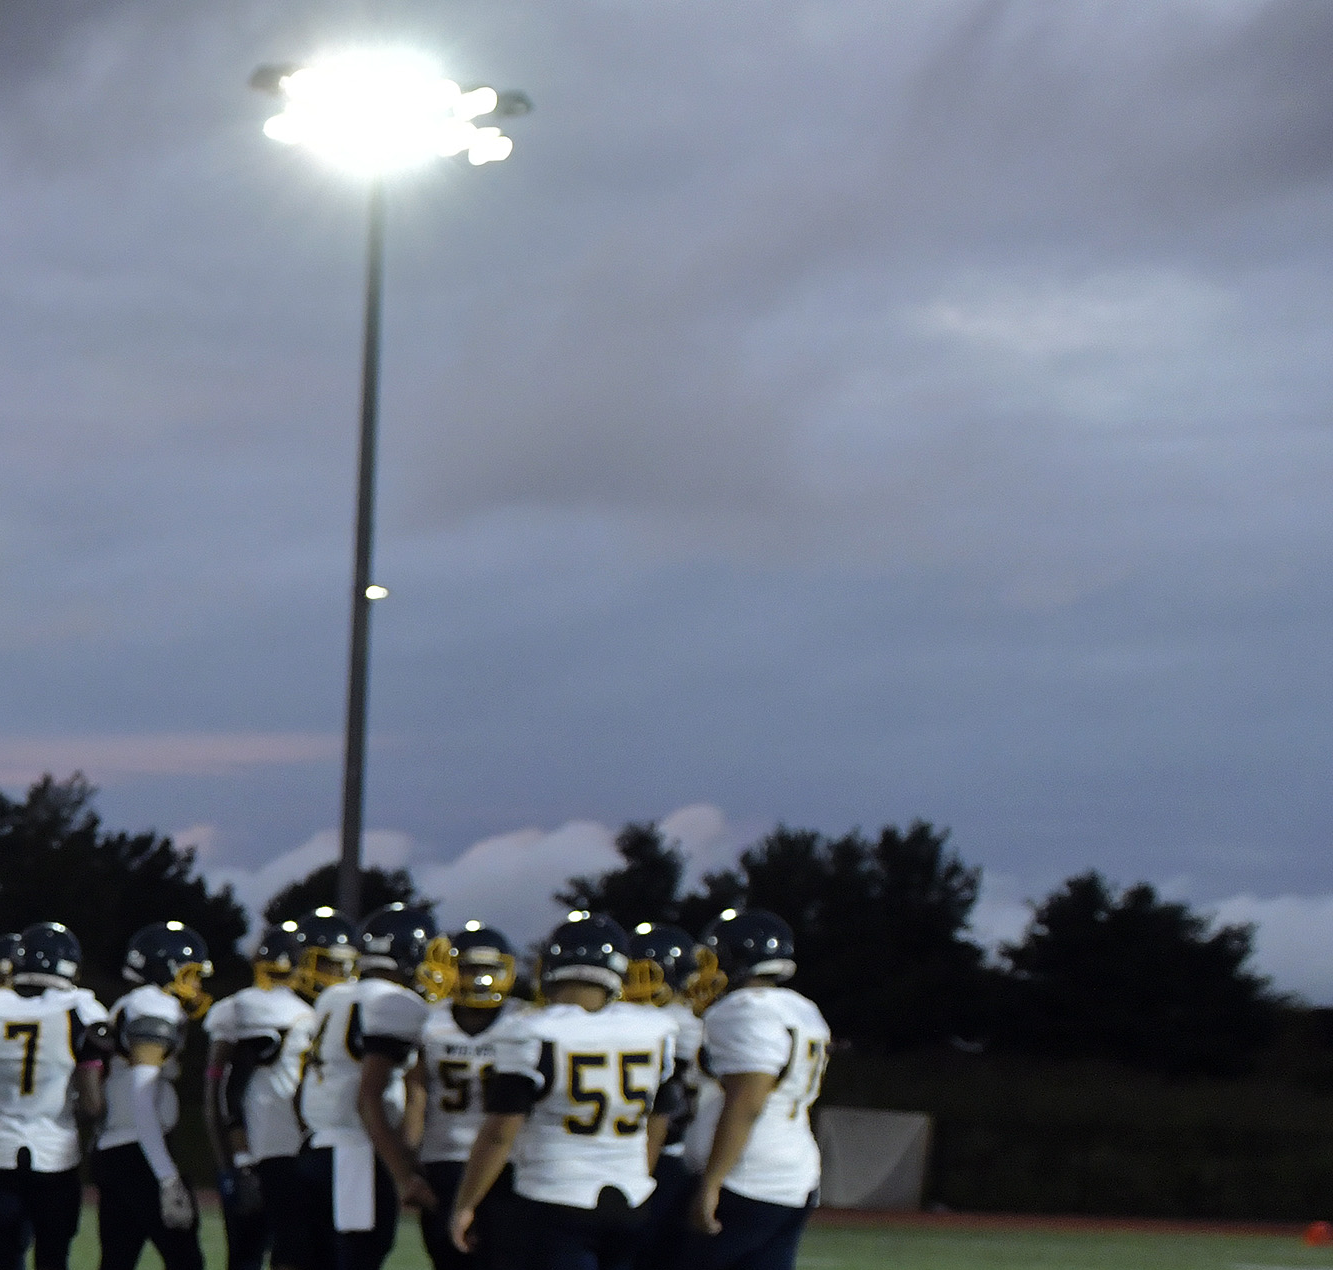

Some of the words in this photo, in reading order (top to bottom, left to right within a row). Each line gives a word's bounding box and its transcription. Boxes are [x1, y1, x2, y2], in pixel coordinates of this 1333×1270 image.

[4, 1020, 40, 1096] 7
[438, 1060, 496, 1113] 5
[564, 1052, 653, 1137] 55
